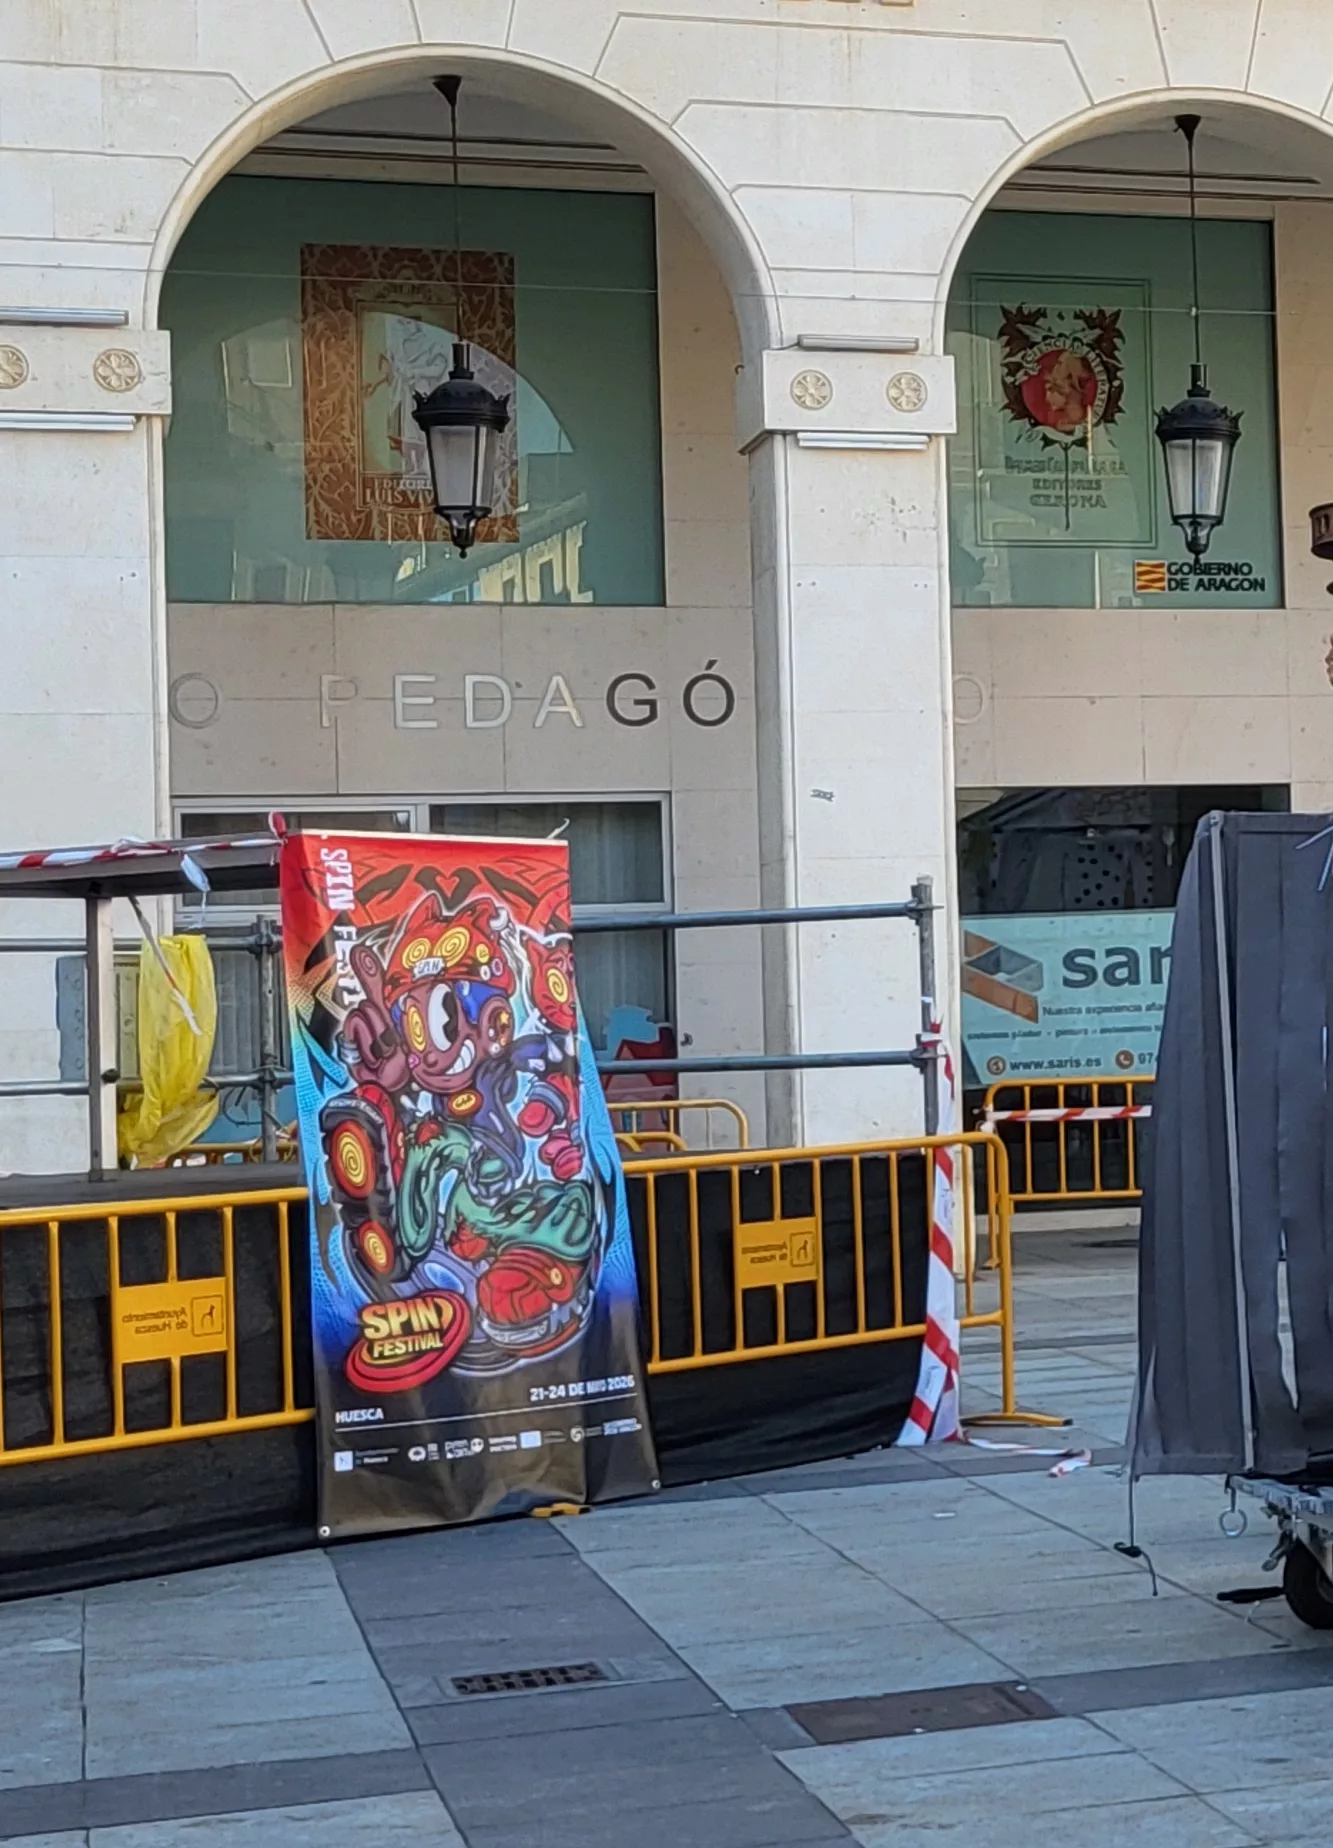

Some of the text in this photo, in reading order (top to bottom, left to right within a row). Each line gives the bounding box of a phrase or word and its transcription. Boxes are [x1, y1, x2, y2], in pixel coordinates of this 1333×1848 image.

[1167, 562, 1253, 576] GOBIERNO
[1167, 578, 1265, 591] DE ARAGON
[320, 848, 355, 911] SPIN
[1010, 1057, 1101, 1072] www.saris.es
[361, 1298, 442, 1339] SPIN
[373, 1331, 444, 1359] FESTIVAL
[530, 1384, 566, 1402] 21-24
[568, 1382, 585, 1396] DE
[335, 1407, 385, 1424] HUESCA
